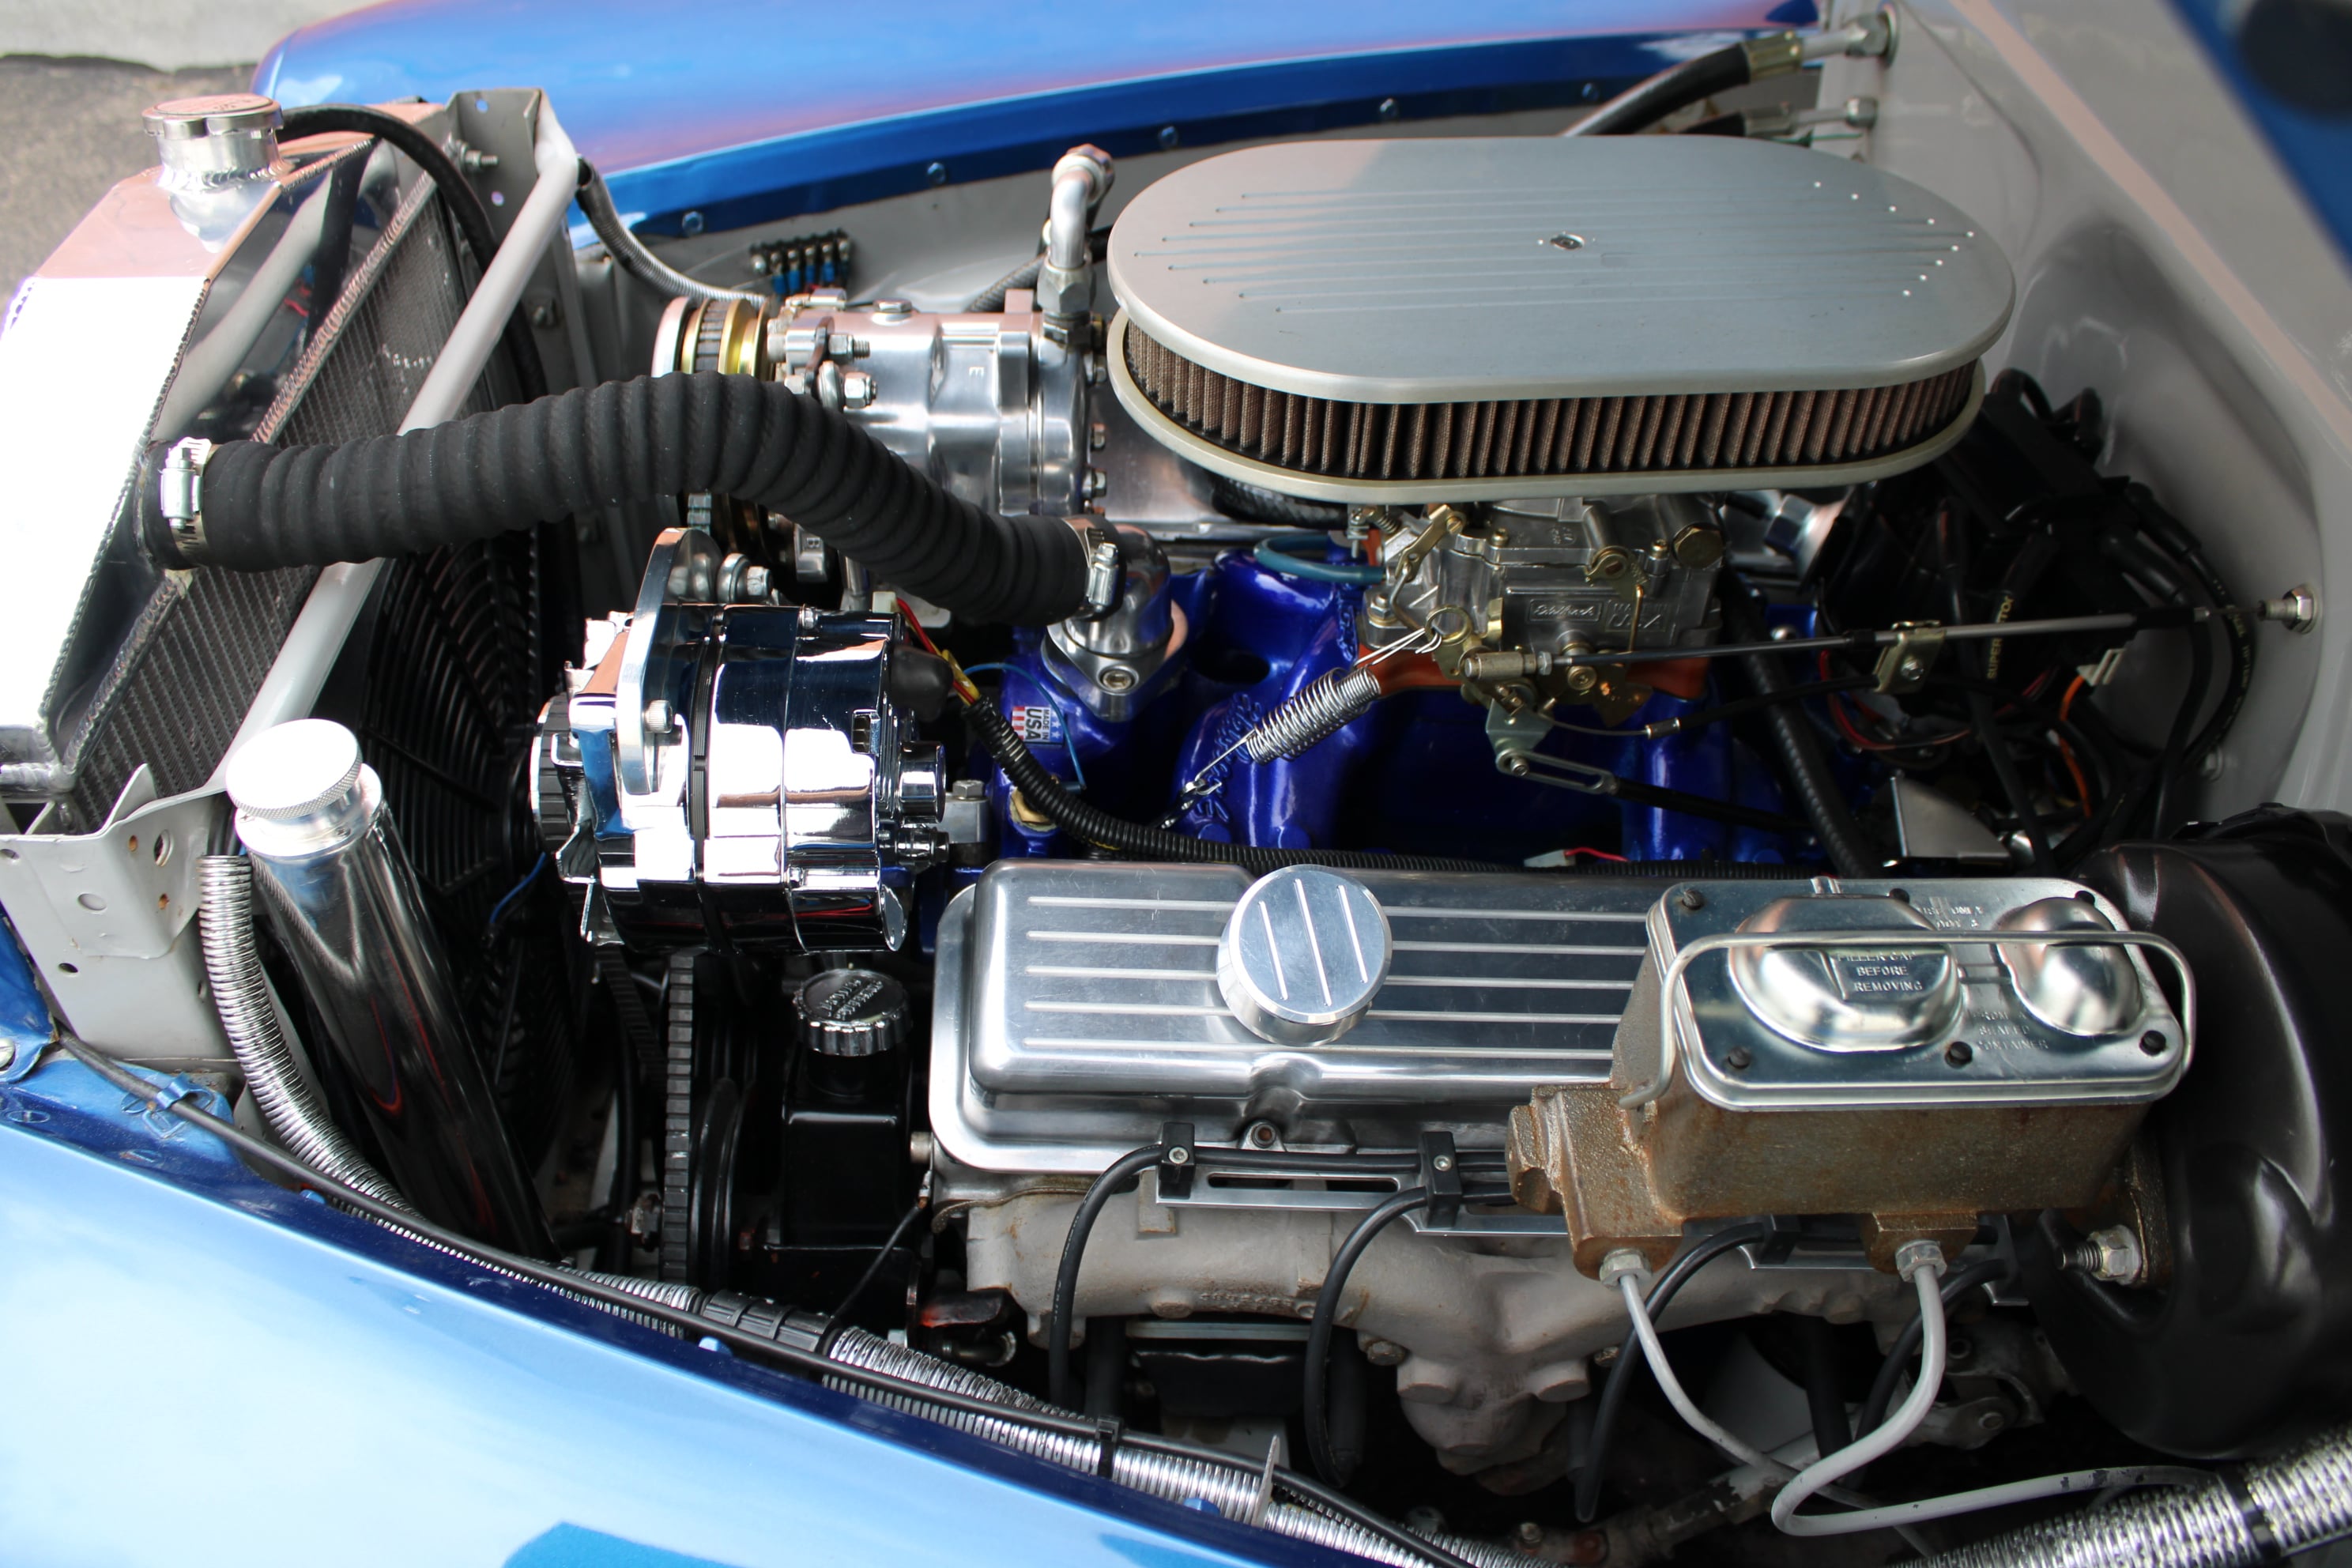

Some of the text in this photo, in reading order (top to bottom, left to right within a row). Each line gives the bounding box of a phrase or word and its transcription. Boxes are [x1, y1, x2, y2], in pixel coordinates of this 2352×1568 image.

[1025, 708, 1042, 741] USA
[1042, 731, 1050, 741] IN
[1890, 951, 1917, 962] CAP
[1856, 965, 1909, 977] BEFORE
[1854, 980, 1924, 993] REMOVING
